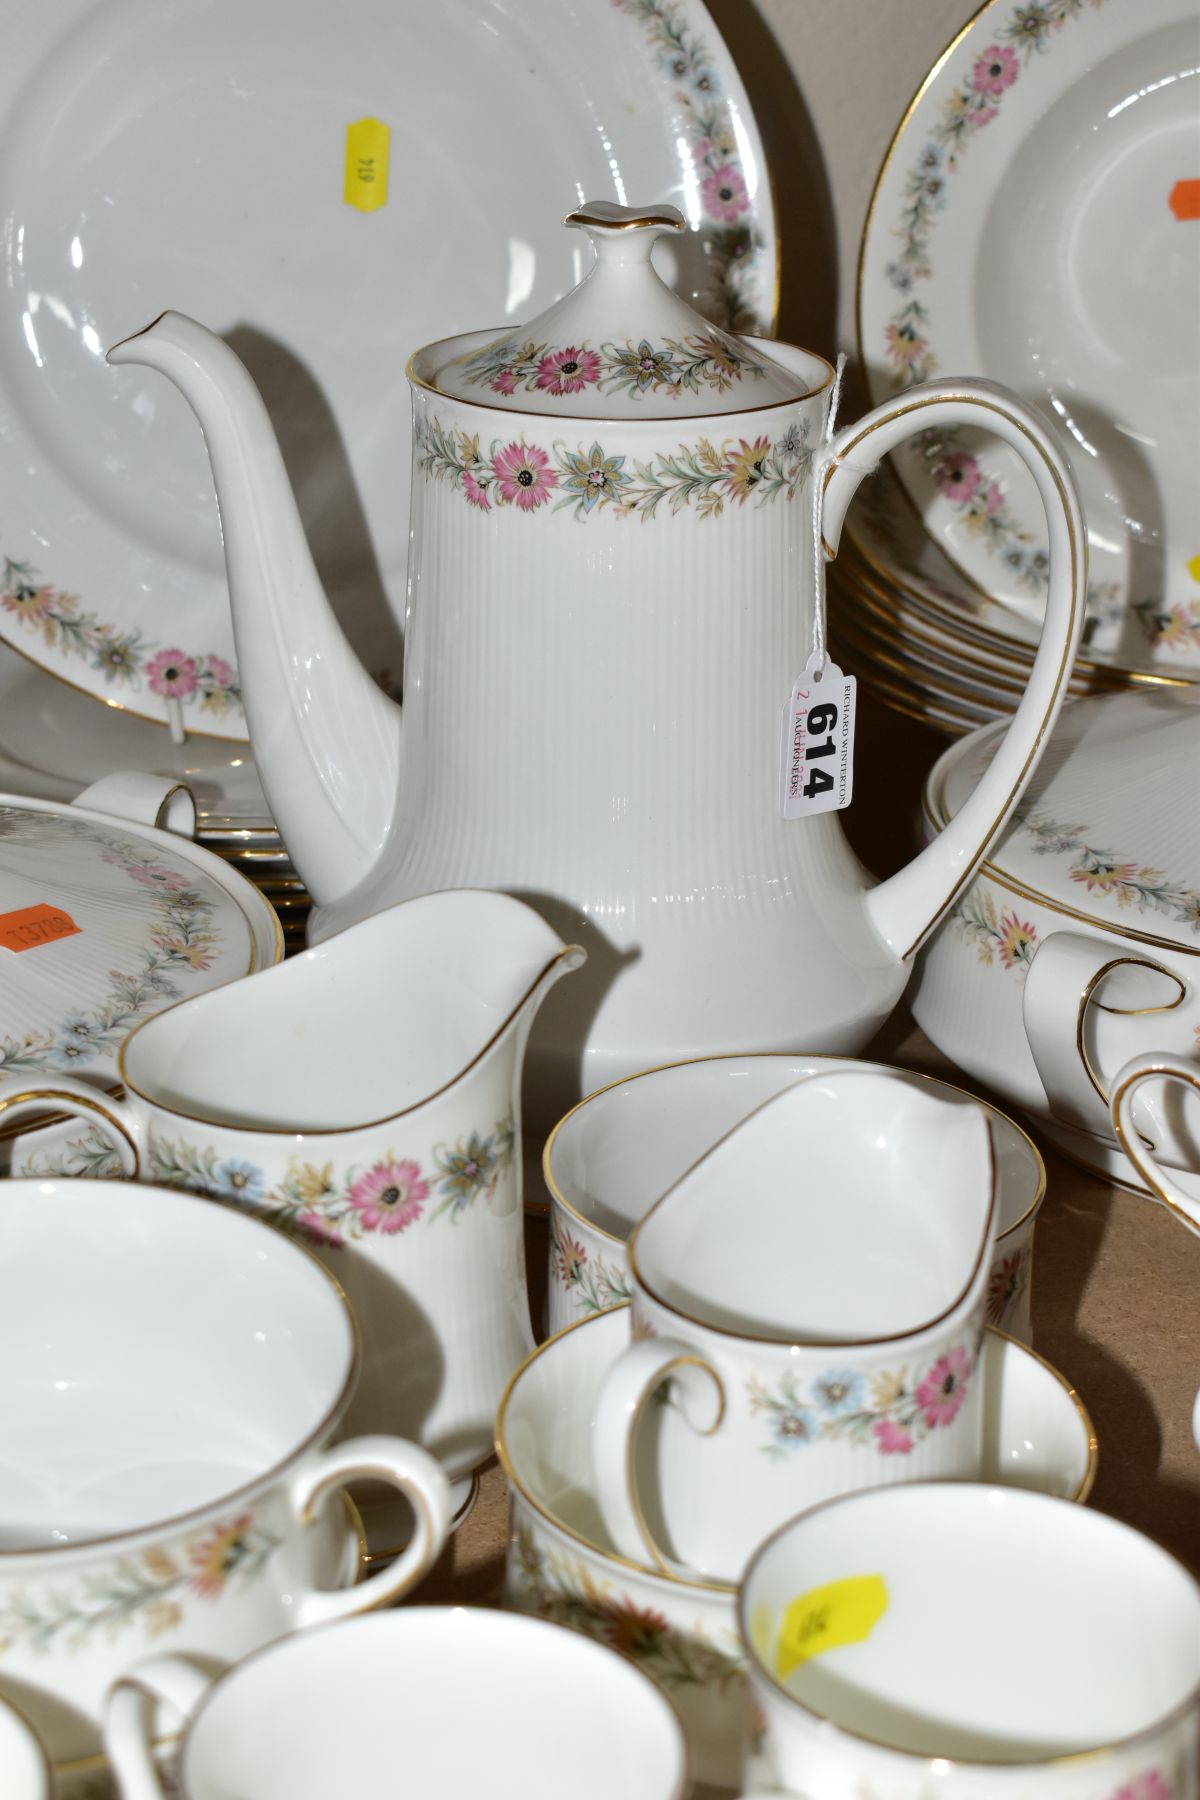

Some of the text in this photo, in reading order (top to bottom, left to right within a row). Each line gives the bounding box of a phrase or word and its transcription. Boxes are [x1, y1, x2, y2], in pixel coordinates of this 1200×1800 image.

[791, 716, 803, 796] AUCTIONEERS
[803, 702, 838, 799] 614
[839, 685, 851, 805] RICHARD WINTERTON
